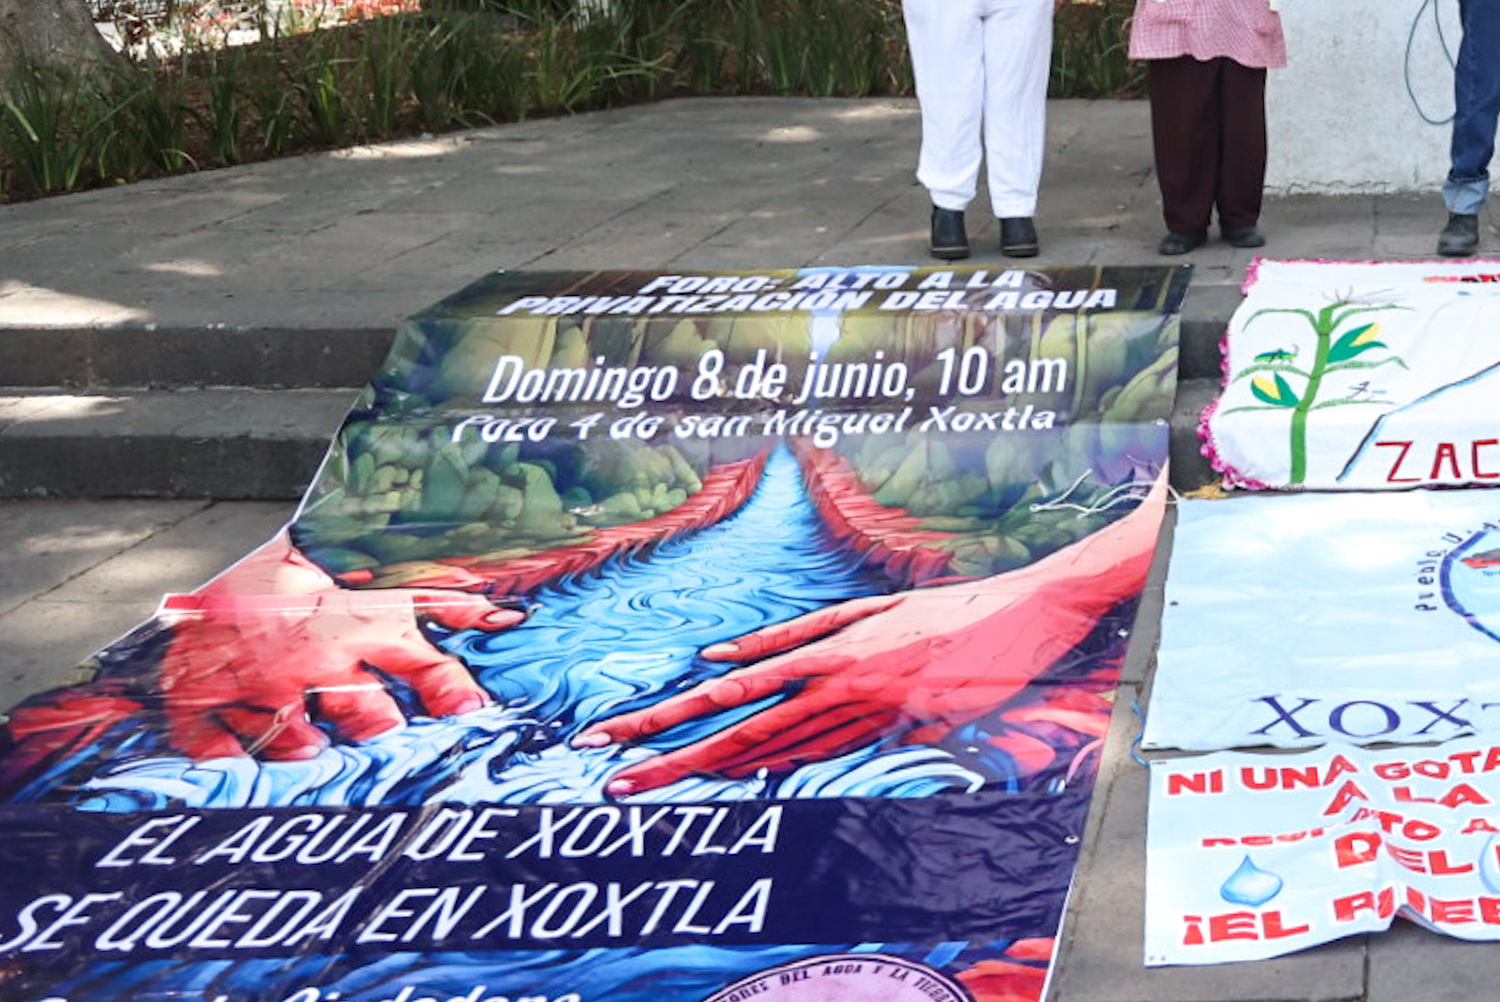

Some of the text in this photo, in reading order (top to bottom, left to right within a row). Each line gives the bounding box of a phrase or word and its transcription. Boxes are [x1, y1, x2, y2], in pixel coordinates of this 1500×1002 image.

[498, 288, 1118, 315] PRIVATIZACIÓN DEL AGUA
[641, 270, 1026, 294] FORO: ALTO A LA
[482, 346, 1067, 408] Domingo 8 de junio, 10 am
[451, 404, 1056, 448] Pozo 4 de san Miguel Xoxtla
[1167, 768, 1223, 795] NI
[1240, 754, 1358, 790] UNA
[1324, 779, 1369, 816] A
[1393, 783, 1490, 809] LA
[95, 804, 784, 870] EL AGUA DE XOXTLA
[1461, 818, 1500, 835] A
[1334, 831, 1474, 870] DEL
[0, 878, 776, 954] SE QUEDA EN XOXTLA
[1182, 909, 1310, 946] ¡EL
